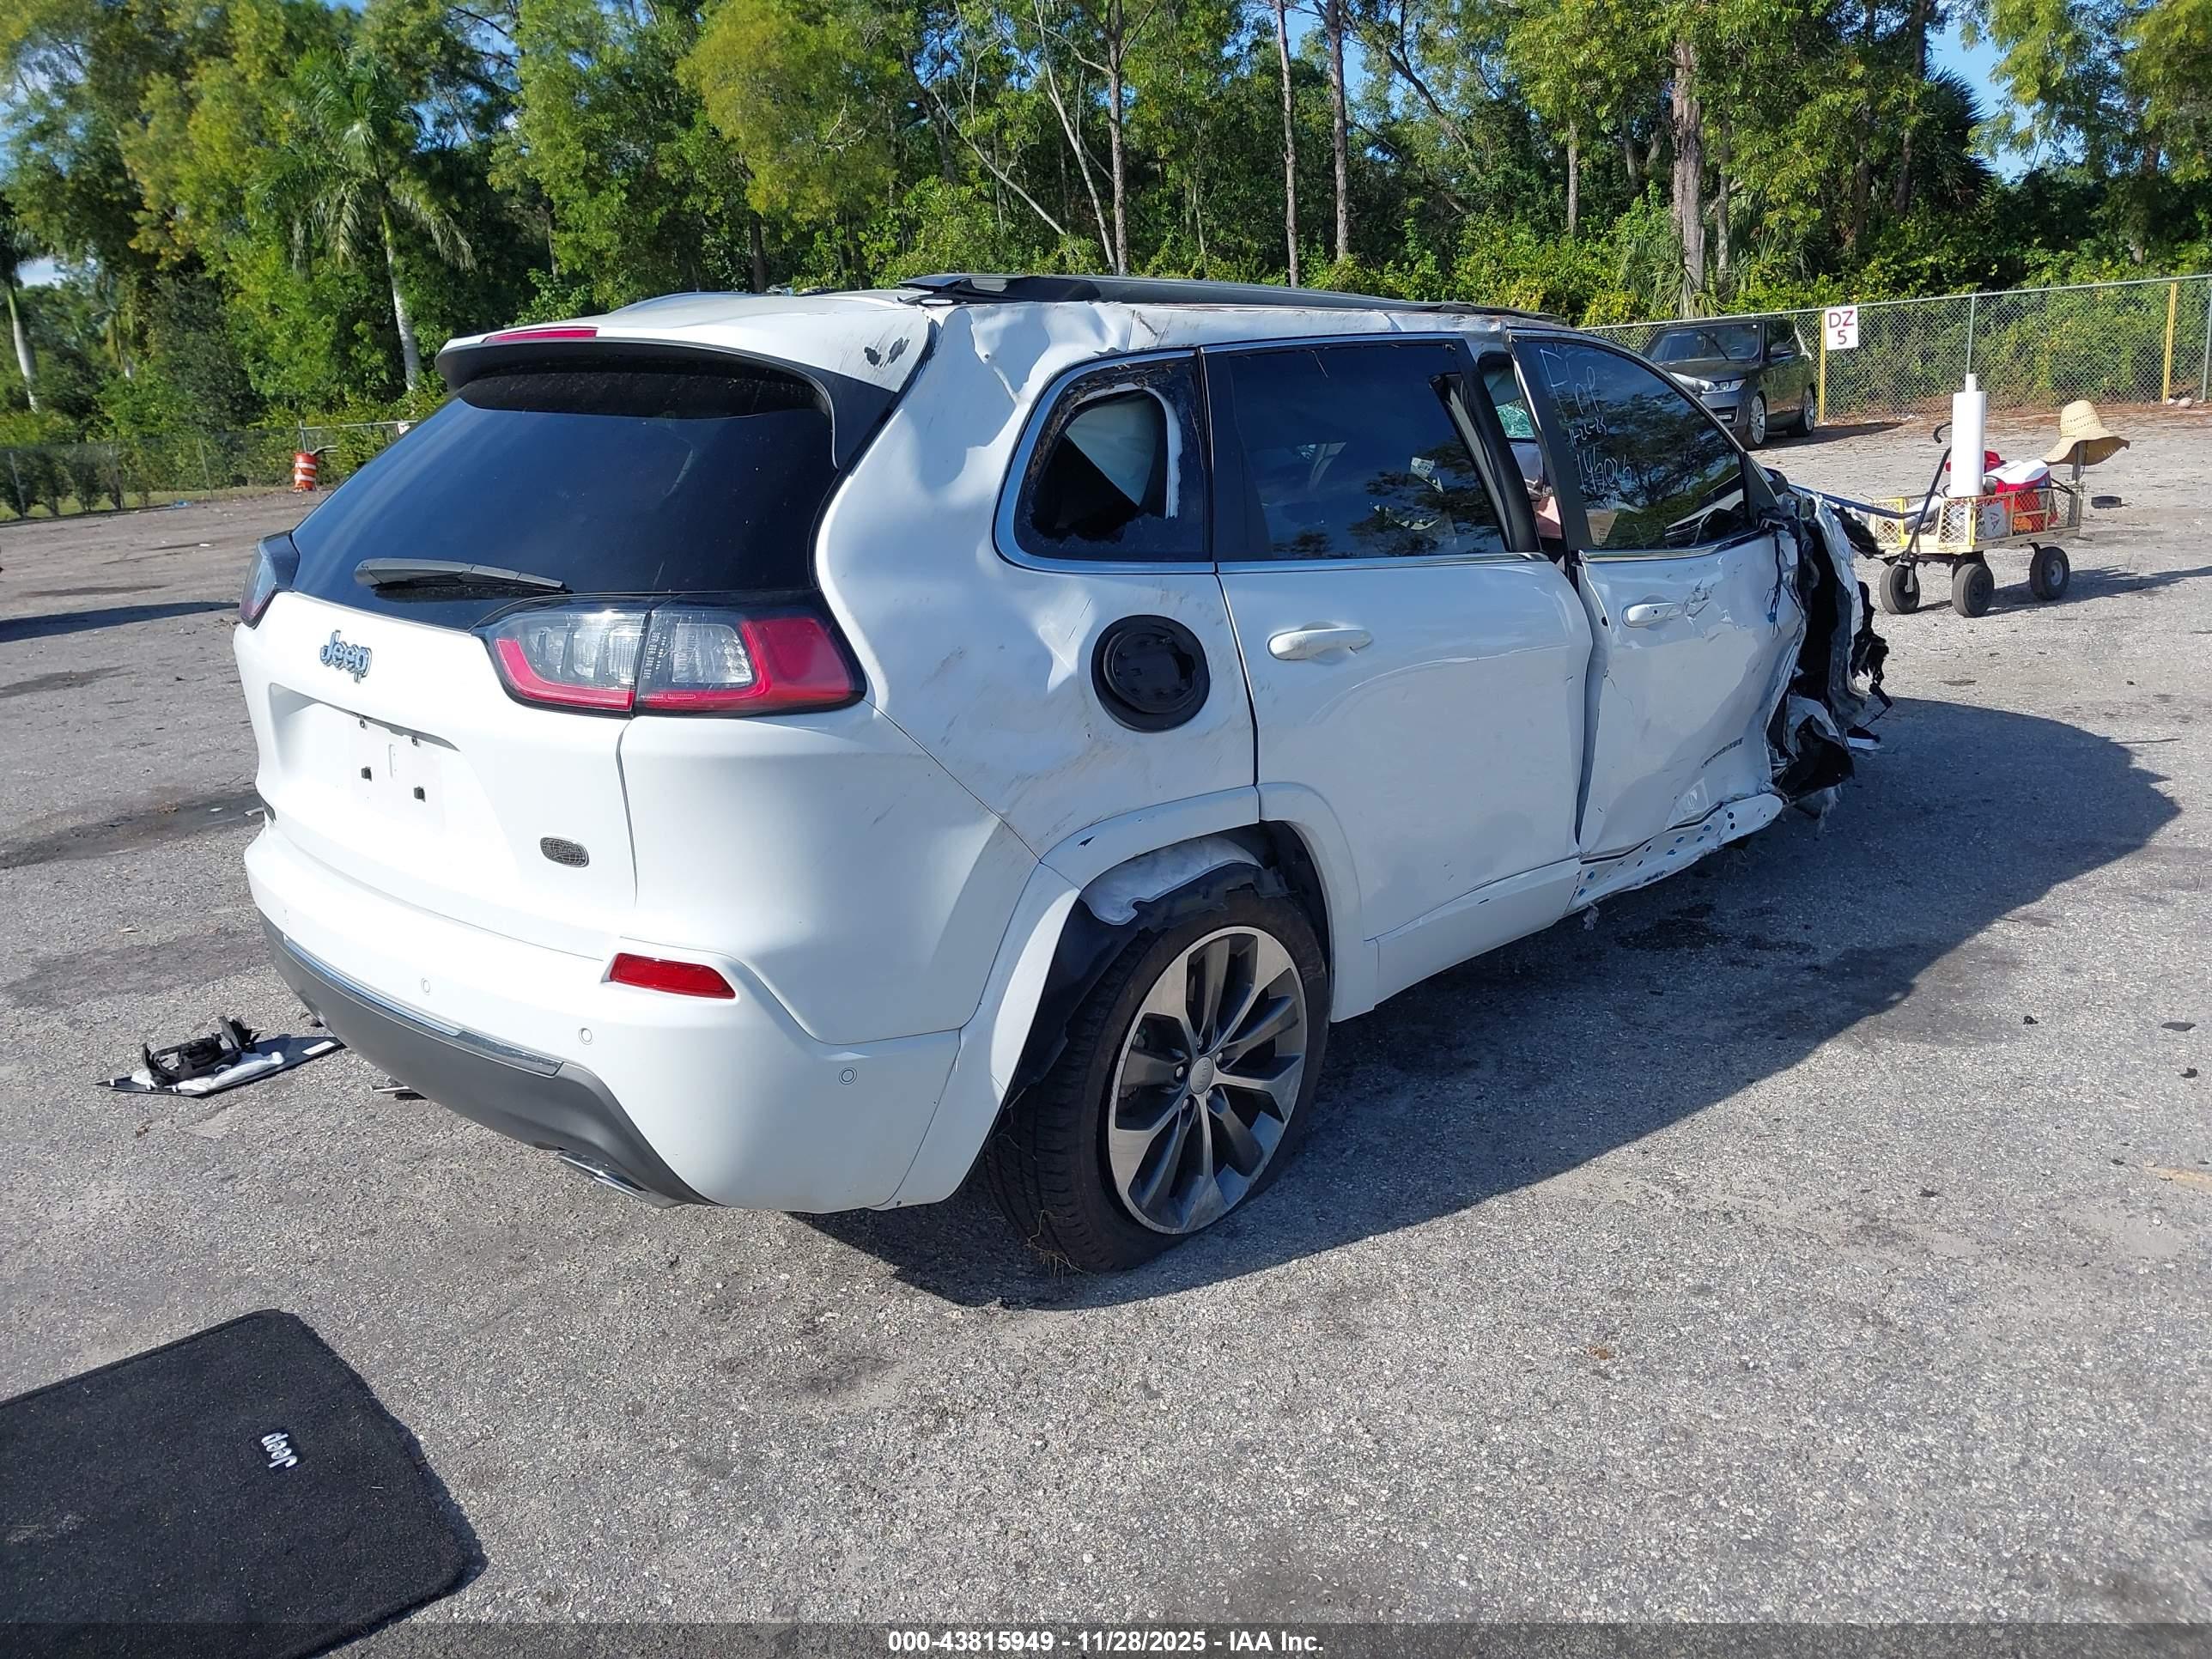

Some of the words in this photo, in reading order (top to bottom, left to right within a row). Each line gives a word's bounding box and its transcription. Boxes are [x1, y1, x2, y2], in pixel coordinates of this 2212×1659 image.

[1828, 310, 1855, 328] DZ
[1838, 330, 1847, 345] 5
[320, 629, 372, 684] Jeep
[261, 1432, 297, 1468] Jeep
